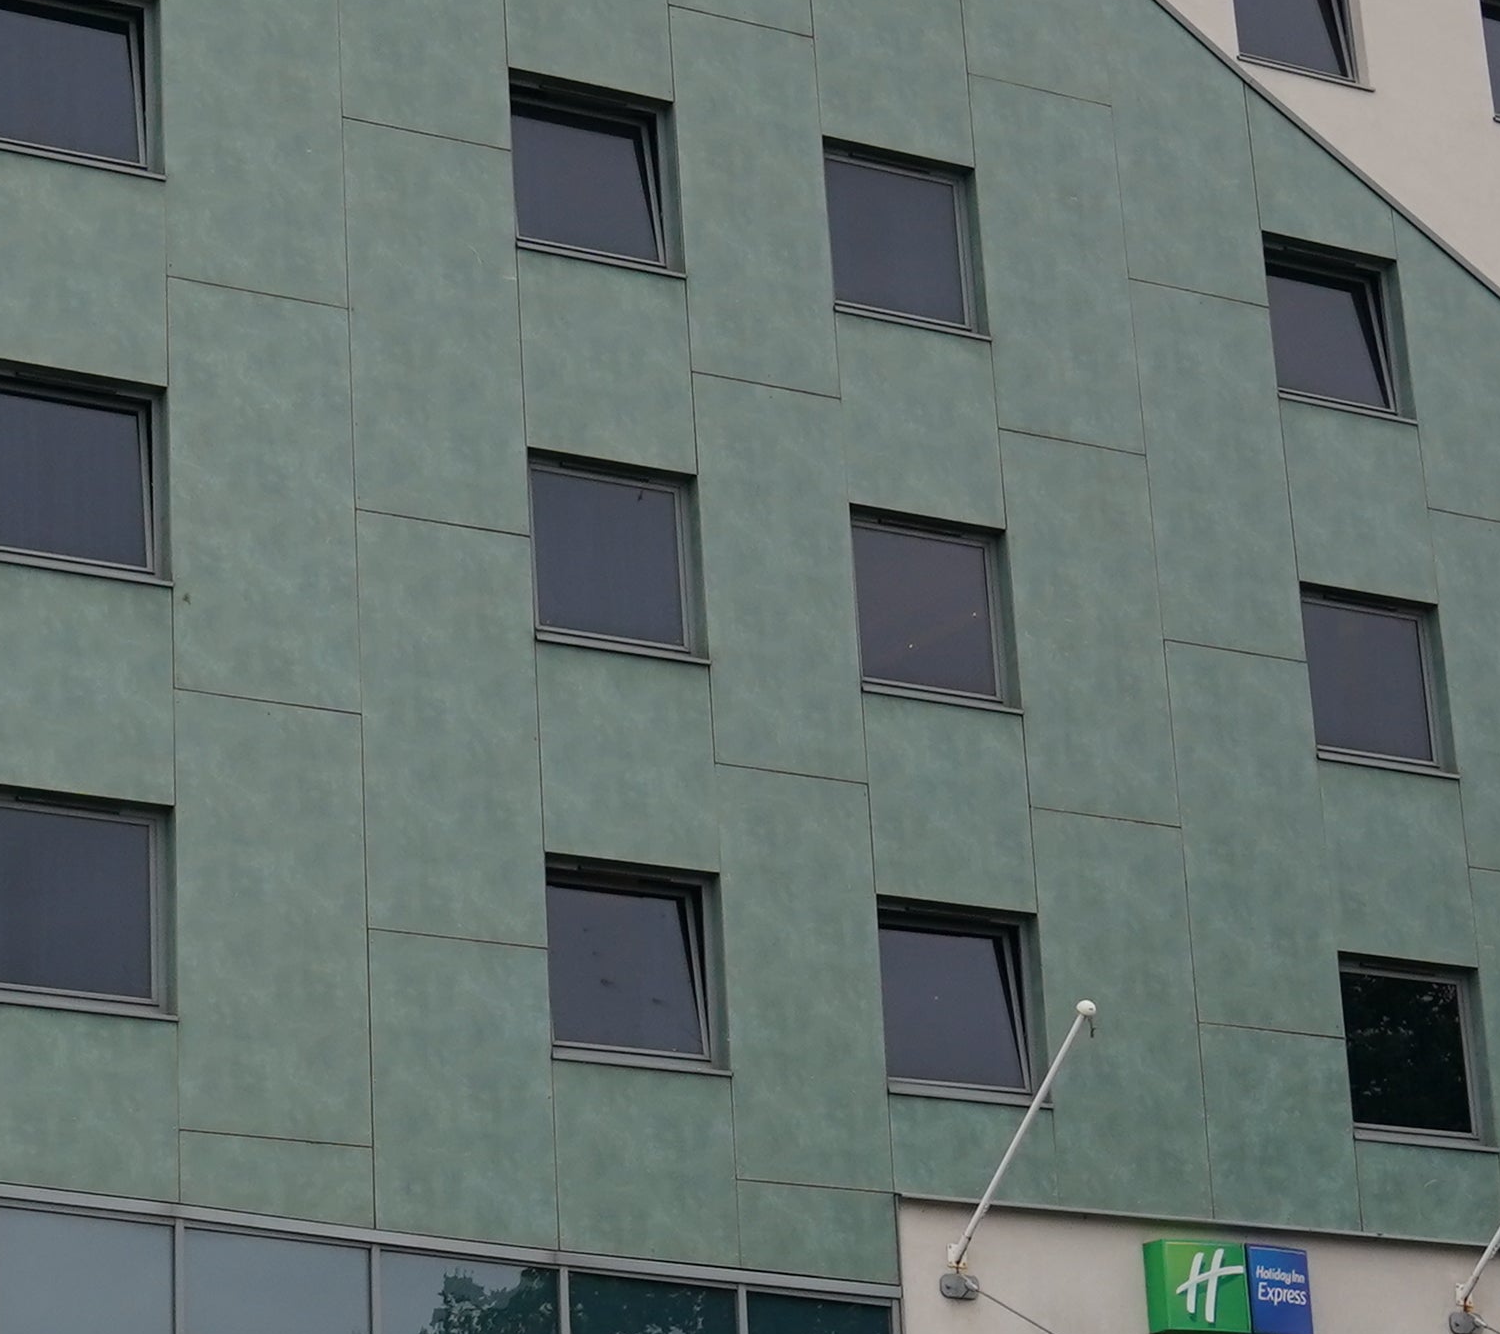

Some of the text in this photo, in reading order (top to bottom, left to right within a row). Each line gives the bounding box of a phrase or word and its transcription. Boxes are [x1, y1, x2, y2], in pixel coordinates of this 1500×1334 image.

[1256, 1265, 1305, 1285] Holiday Inn
[1258, 1282, 1307, 1306] Express
